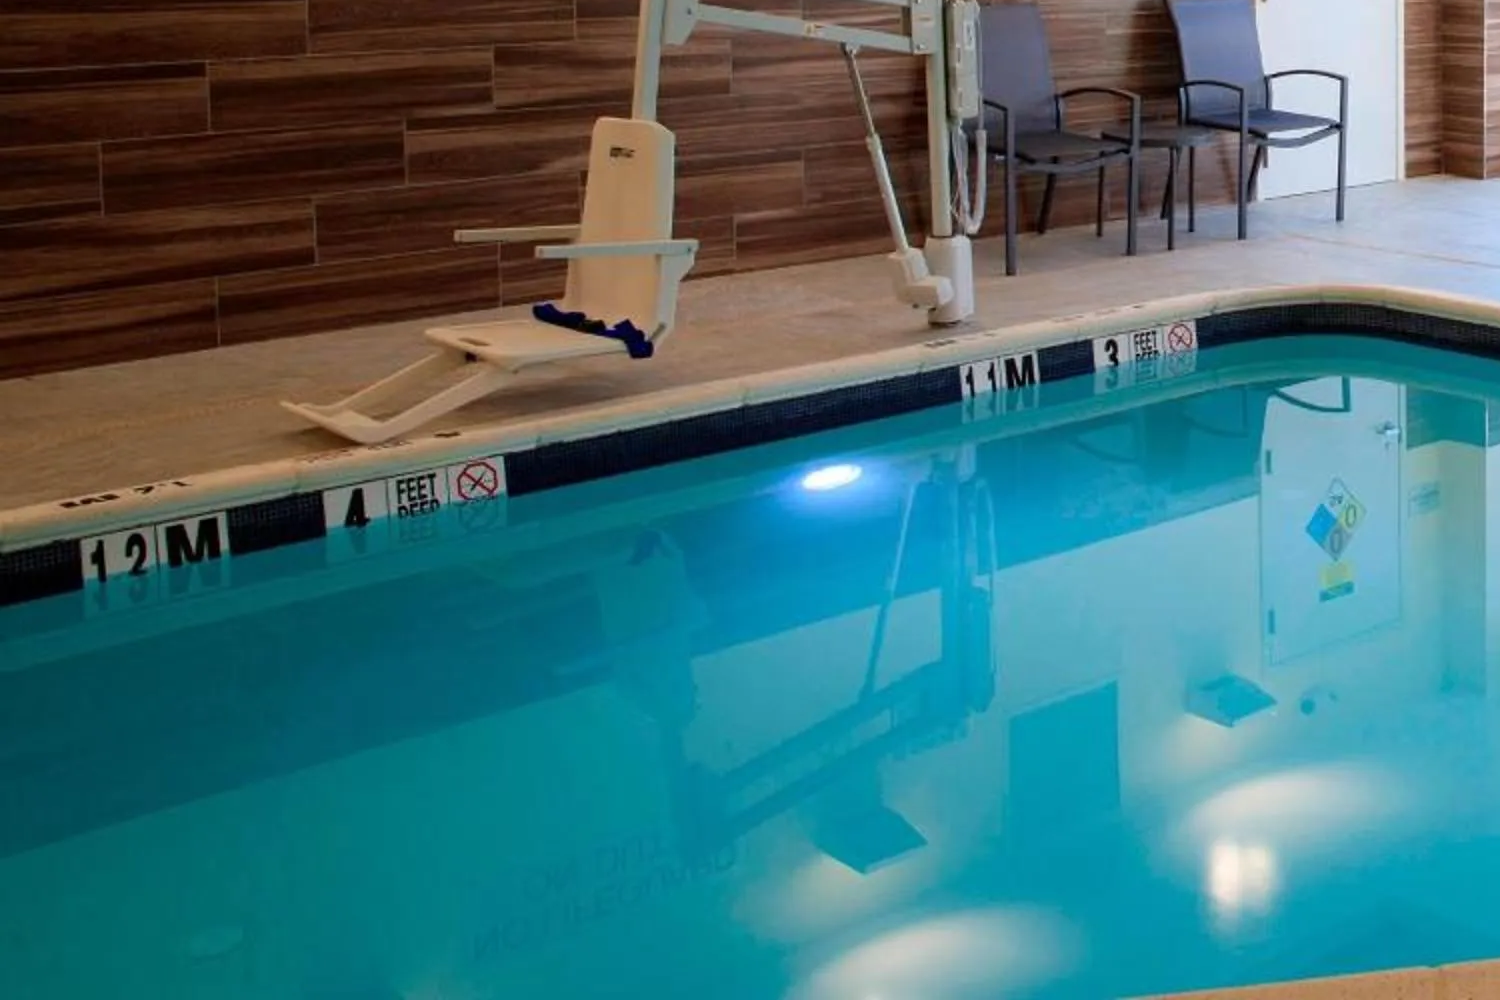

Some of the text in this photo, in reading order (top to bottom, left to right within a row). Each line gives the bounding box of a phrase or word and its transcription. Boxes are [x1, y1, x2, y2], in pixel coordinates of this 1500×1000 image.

[1103, 338, 1120, 367] 3
[1133, 330, 1157, 353] FEET
[344, 472, 438, 528] 4 FEET
